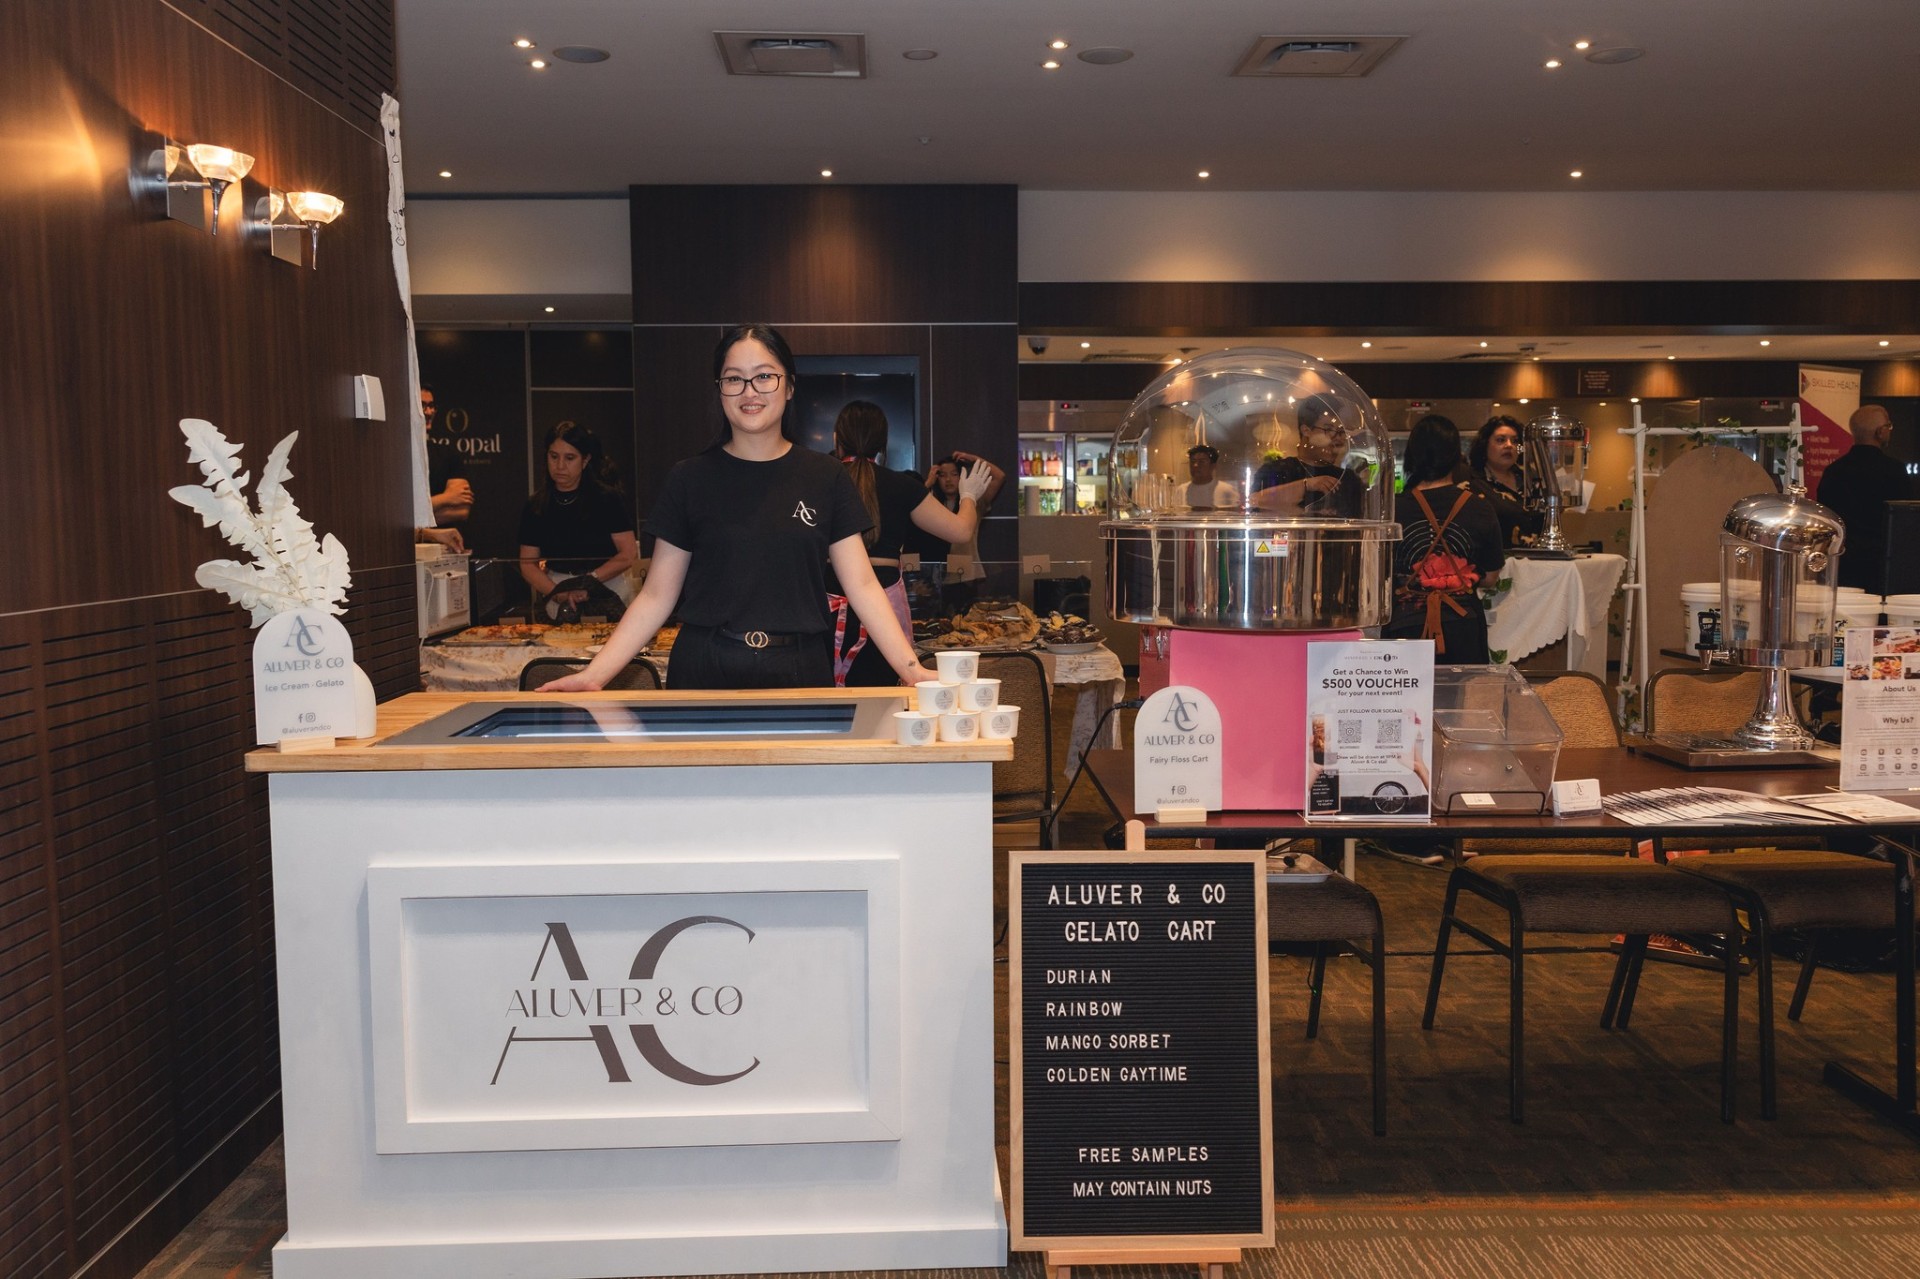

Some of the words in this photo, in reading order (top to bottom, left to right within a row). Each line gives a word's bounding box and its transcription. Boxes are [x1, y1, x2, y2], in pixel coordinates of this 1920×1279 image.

[1812, 378, 1835, 388] SKILLED
[1837, 380, 1858, 390] HEALTH
[457, 433, 501, 456] opal
[263, 660, 311, 672] ALUVER
[315, 659, 322, 669] &
[326, 657, 344, 668] CO
[265, 684, 278, 692] Ice
[316, 680, 344, 688] Gelato
[1322, 678, 1352, 689] $500
[1356, 678, 1419, 688] VOUCHER
[1144, 735, 1185, 745] ALUVER
[1189, 735, 1195, 744] &
[1199, 734, 1215, 744] CO
[1150, 756, 1168, 765] Fairy
[1048, 884, 1143, 906] ALUVER
[1167, 884, 1180, 904] &
[1202, 883, 1226, 904] CO
[1064, 921, 1140, 942] GELATO
[1168, 920, 1216, 941] CART
[1047, 970, 1112, 984] DURIAN
[505, 987, 644, 1018] ALUVER
[656, 987, 679, 1016] &
[691, 985, 743, 1016] CO
[1046, 1002, 1123, 1017] RAINBOW
[1046, 1034, 1101, 1050] MANGO
[1109, 1034, 1171, 1049] SORBET
[1047, 1067, 1110, 1083] GOLDEN
[1120, 1066, 1187, 1082] GAYTIME
[1079, 1148, 1121, 1163] FREE
[1132, 1147, 1208, 1162] SAMPLES
[1073, 1182, 1104, 1197] MAY
[1111, 1181, 1170, 1196] CONTAIN
[1176, 1180, 1212, 1195] NUTS
